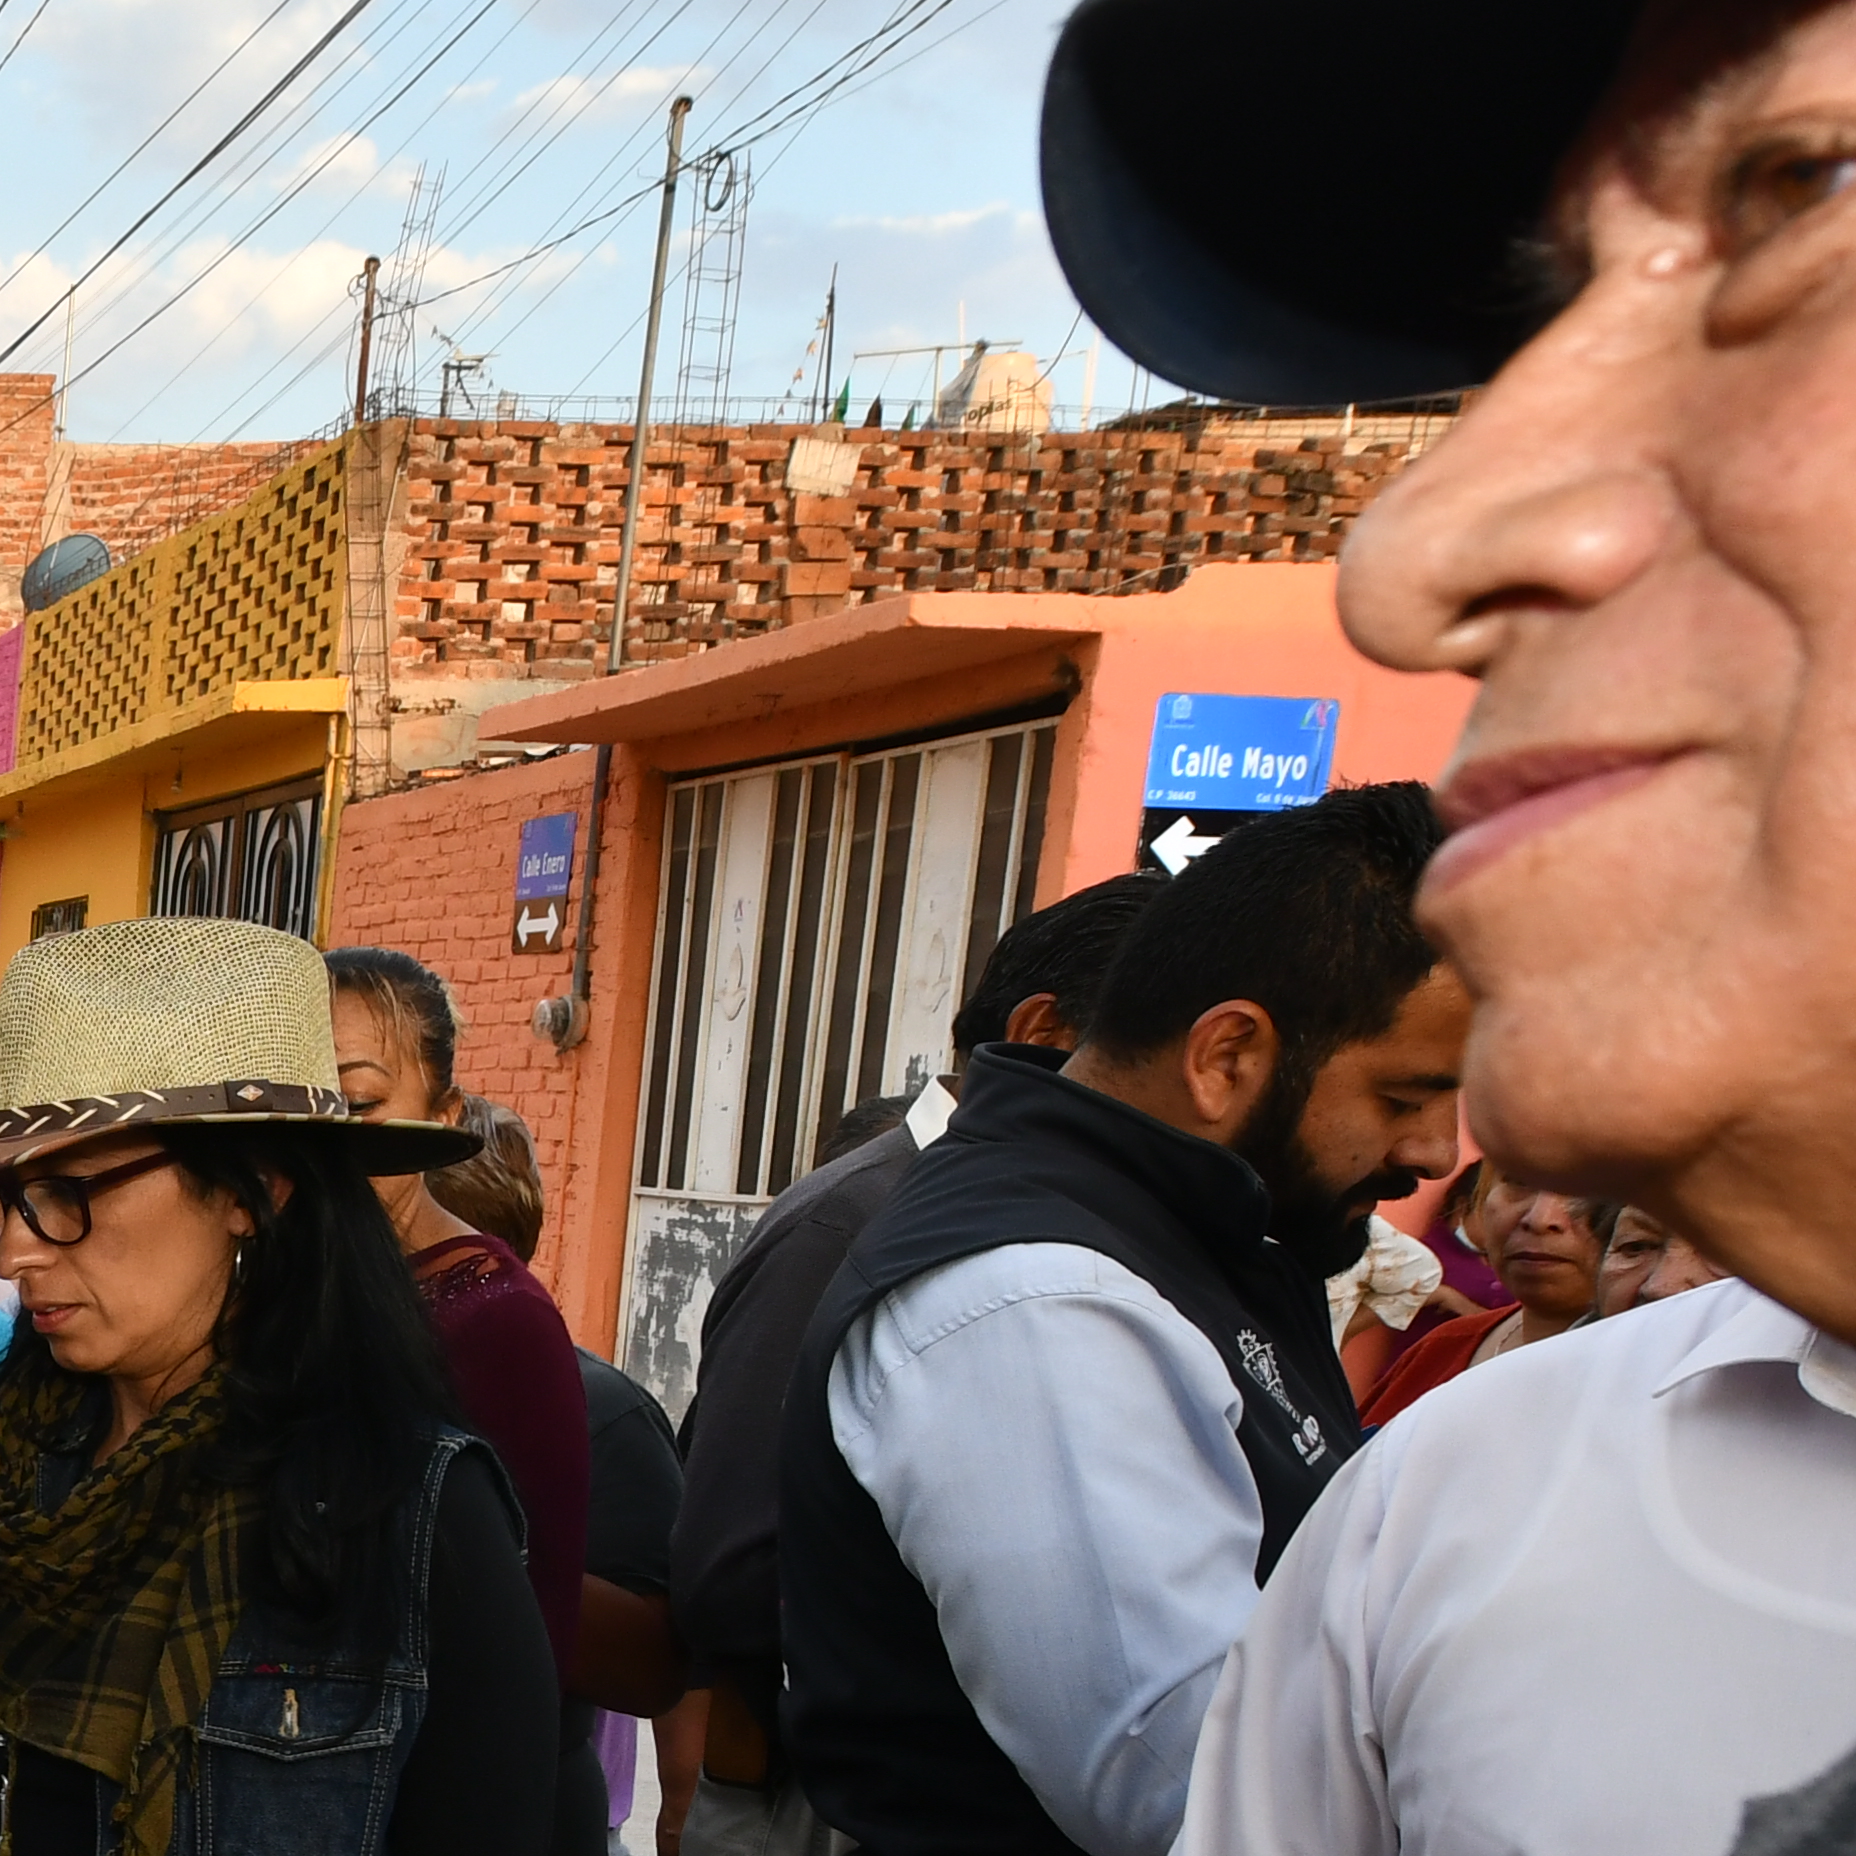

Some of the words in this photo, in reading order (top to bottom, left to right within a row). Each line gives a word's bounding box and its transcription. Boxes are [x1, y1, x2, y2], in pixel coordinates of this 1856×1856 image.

[1171, 744, 1233, 778] Calle
[1241, 746, 1308, 788] Mayo
[522, 854, 540, 878] Calle
[542, 852, 565, 875] Enero
